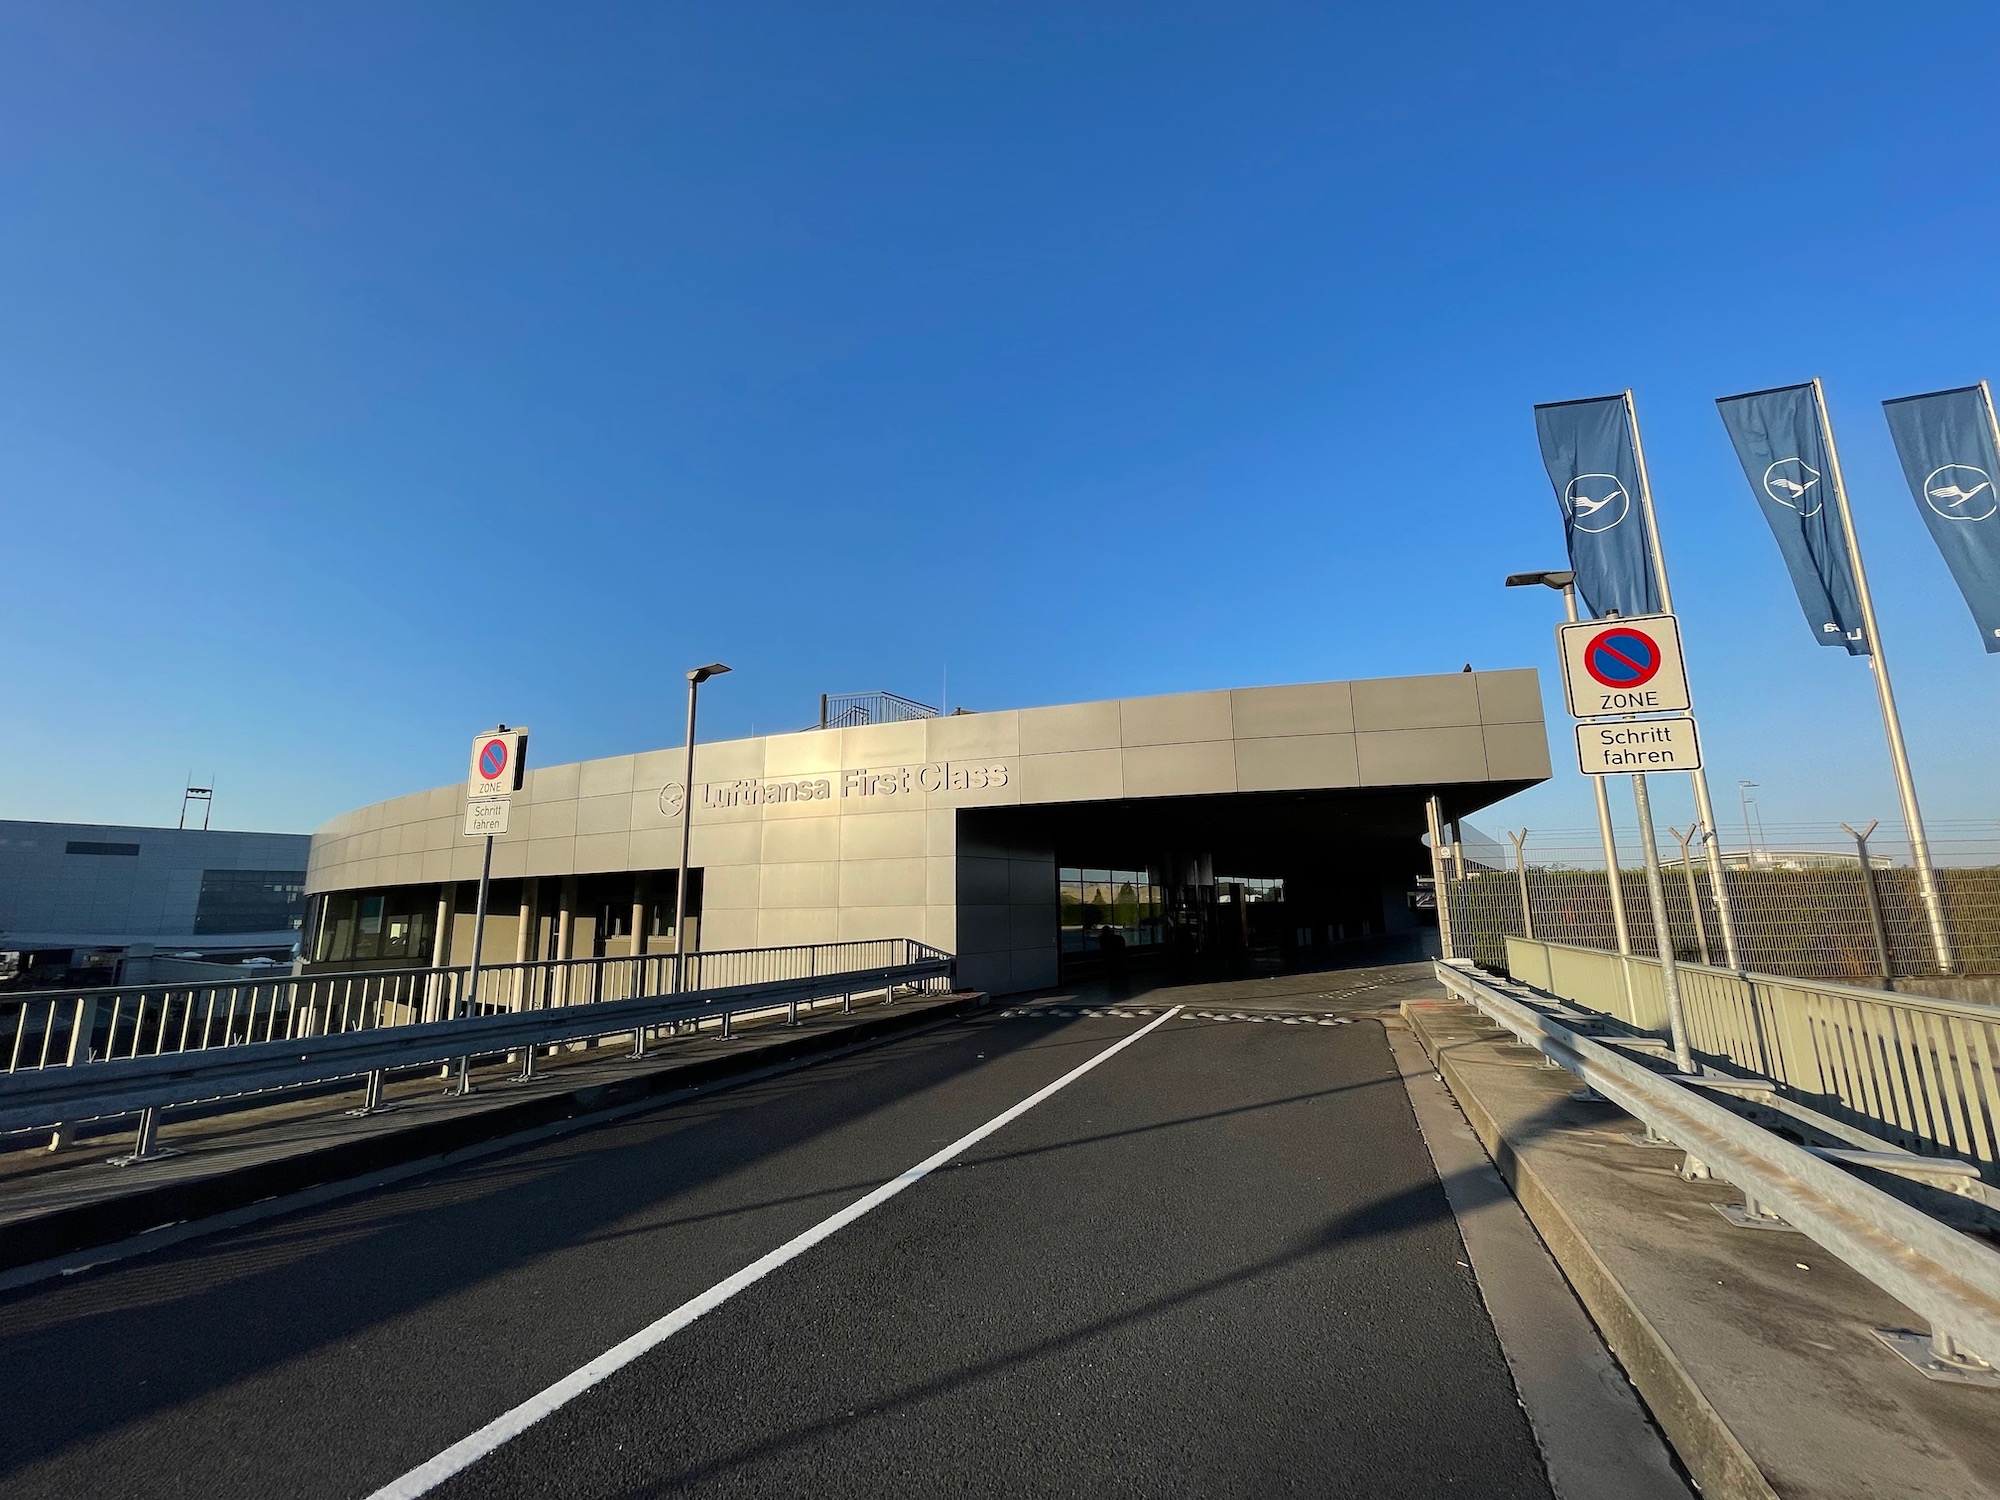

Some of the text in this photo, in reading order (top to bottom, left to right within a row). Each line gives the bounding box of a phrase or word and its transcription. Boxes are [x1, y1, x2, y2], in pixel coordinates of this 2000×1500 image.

[1599, 691, 1659, 710] ZONE
[1600, 727, 1672, 745] Schritt
[1603, 749, 1674, 765] fahren
[479, 781, 502, 794] ZONE
[700, 762, 1009, 809] Lufthansa First Class
[474, 805, 501, 817] Schritt
[473, 819, 500, 830] fahren
